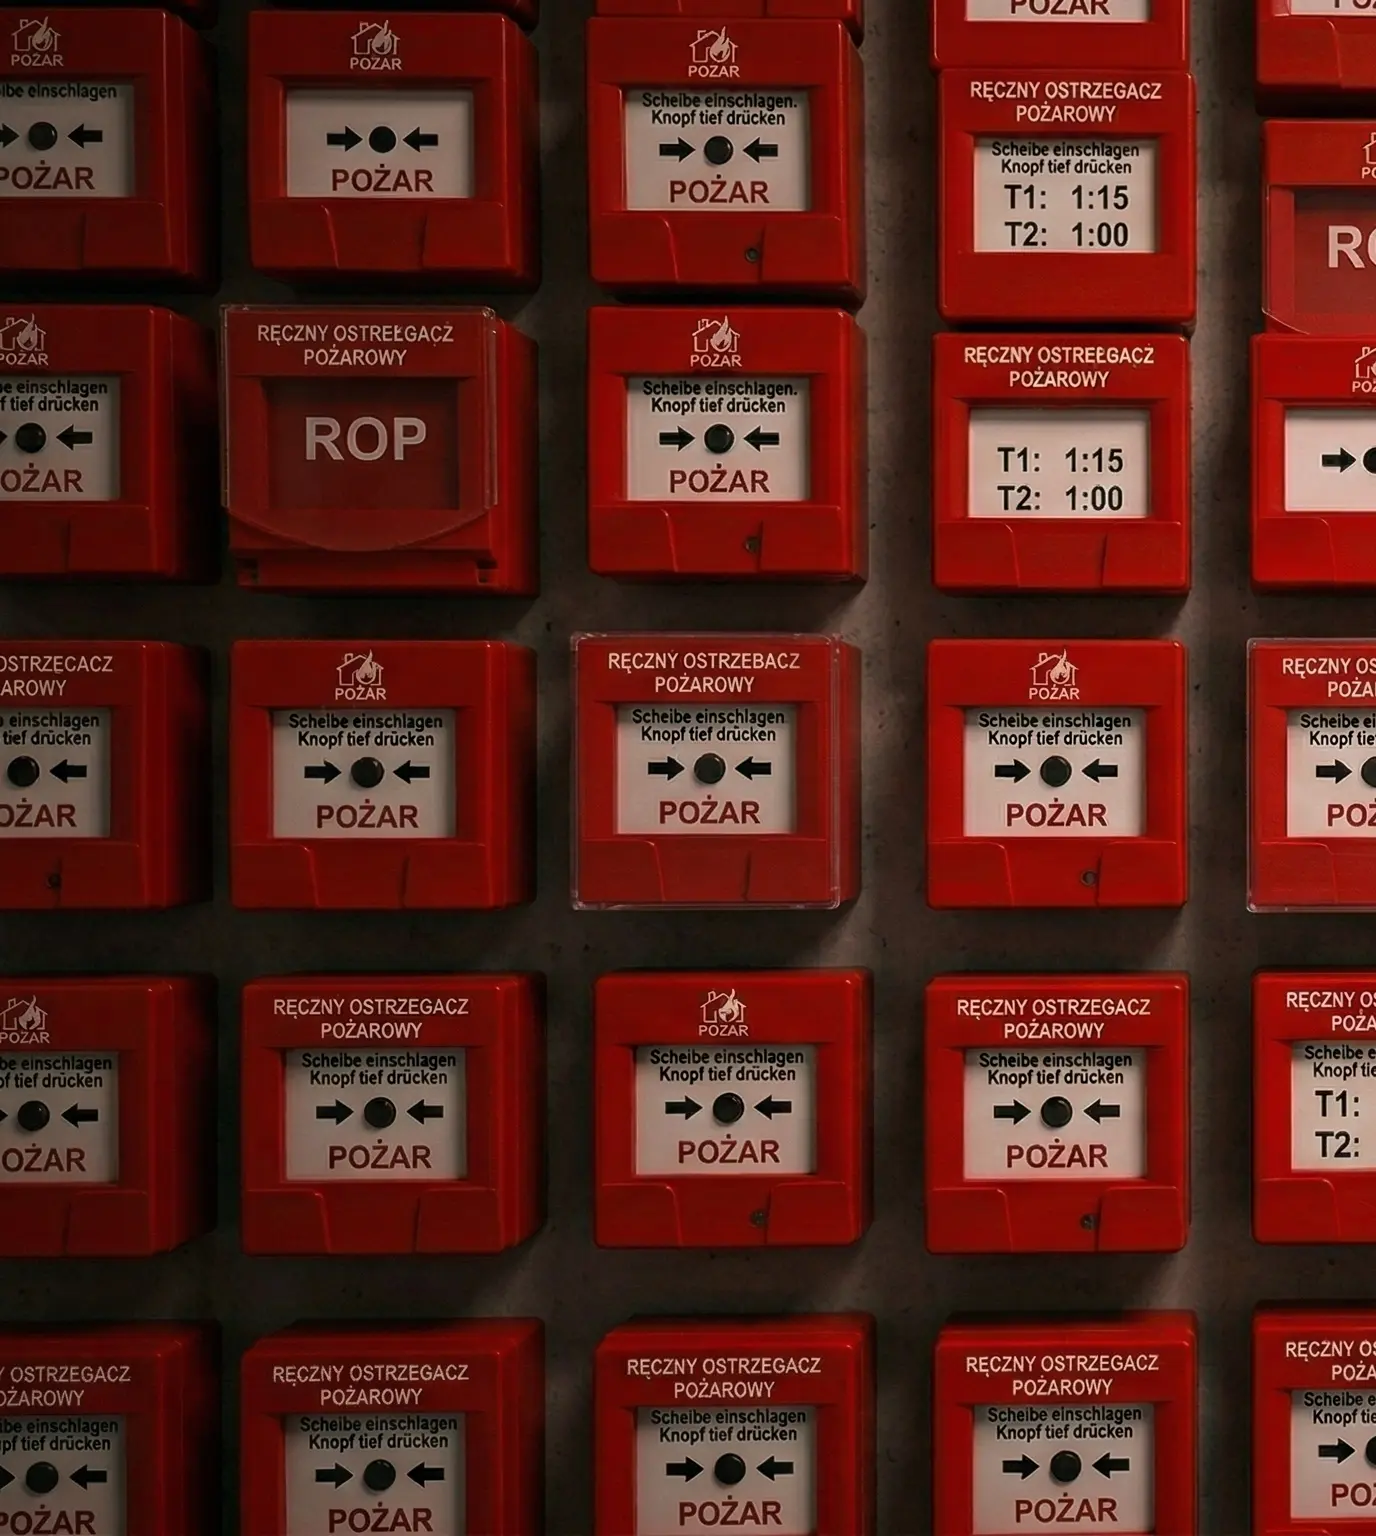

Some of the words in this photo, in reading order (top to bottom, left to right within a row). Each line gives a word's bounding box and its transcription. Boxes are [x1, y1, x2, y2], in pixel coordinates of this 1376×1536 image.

[642, 92, 701, 108] Scheibe
[971, 81, 1040, 102] RĘCZNY
[1045, 81, 1162, 100] OSTRZEGACZ
[652, 109, 696, 128] Knopf
[699, 109, 724, 125] tief
[726, 110, 785, 125] drücken
[1016, 101, 1116, 122] POŻAROWY
[332, 163, 434, 192] POŻAR
[670, 174, 770, 204] POŻAR
[1004, 184, 1046, 209] T1:
[1072, 185, 1128, 210] 1:15
[1004, 221, 1047, 246] T2:
[1072, 222, 1128, 247] 1:00
[306, 417, 426, 461] ROP
[997, 447, 1040, 472] T1:
[1066, 447, 1123, 473] 1:15
[670, 463, 770, 494] POŻAR
[997, 485, 1040, 511] T2:
[1066, 485, 1122, 511] 1:00
[608, 653, 678, 674] RĘCZNY
[684, 652, 800, 669] OSTRZEBACZ
[655, 672, 754, 693] POŻAROWY
[978, 712, 1039, 728] Scheibe
[1042, 712, 1132, 732] einschlagen
[988, 730, 1034, 749] Knopf
[1036, 730, 1060, 746] tief
[1064, 730, 1122, 746] drücken
[317, 798, 418, 829] POŻAR
[660, 794, 760, 824] POŻAR
[1007, 798, 1107, 827] POŻAR
[274, 999, 344, 1019] RĘCZNY
[350, 998, 468, 1015] OSTRZEGACZ
[958, 999, 1028, 1020] RĘCZNY
[1032, 999, 1150, 1016] OSTRZEGACZ
[1286, 991, 1356, 1012] RĘCZNY
[321, 1018, 422, 1039] POŻAROWY
[1304, 1044, 1364, 1060] Scheibe
[1313, 1062, 1358, 1080] Knopf
[1315, 1090, 1359, 1117] T1:
[329, 1139, 432, 1170] POŻAR
[678, 1134, 780, 1164] POŻAR
[1007, 1138, 1108, 1168] POŻAR
[1315, 1131, 1359, 1158] T2:
[628, 1358, 697, 1379] RĘCZNY
[702, 1357, 821, 1374] OSTRZEGACZ
[966, 1356, 1036, 1378] RĘCZNY
[1041, 1354, 1159, 1372] OSTRZEGACZ
[321, 1385, 422, 1406] POŻAROWY
[674, 1378, 775, 1399] POŻAROWY
[1013, 1375, 1113, 1396] POŻAROWY
[1304, 1391, 1364, 1407] Scheibe
[651, 1409, 712, 1425] Scheibe
[715, 1408, 806, 1428] einschlagen
[1313, 1408, 1358, 1428] Knopf
[660, 1426, 706, 1446] Knopf
[708, 1426, 734, 1442] tief
[736, 1425, 797, 1442] drücken
[328, 1502, 433, 1534] POŻAR
[679, 1495, 782, 1526] POŻAR
[1015, 1492, 1118, 1523] POŻAR
